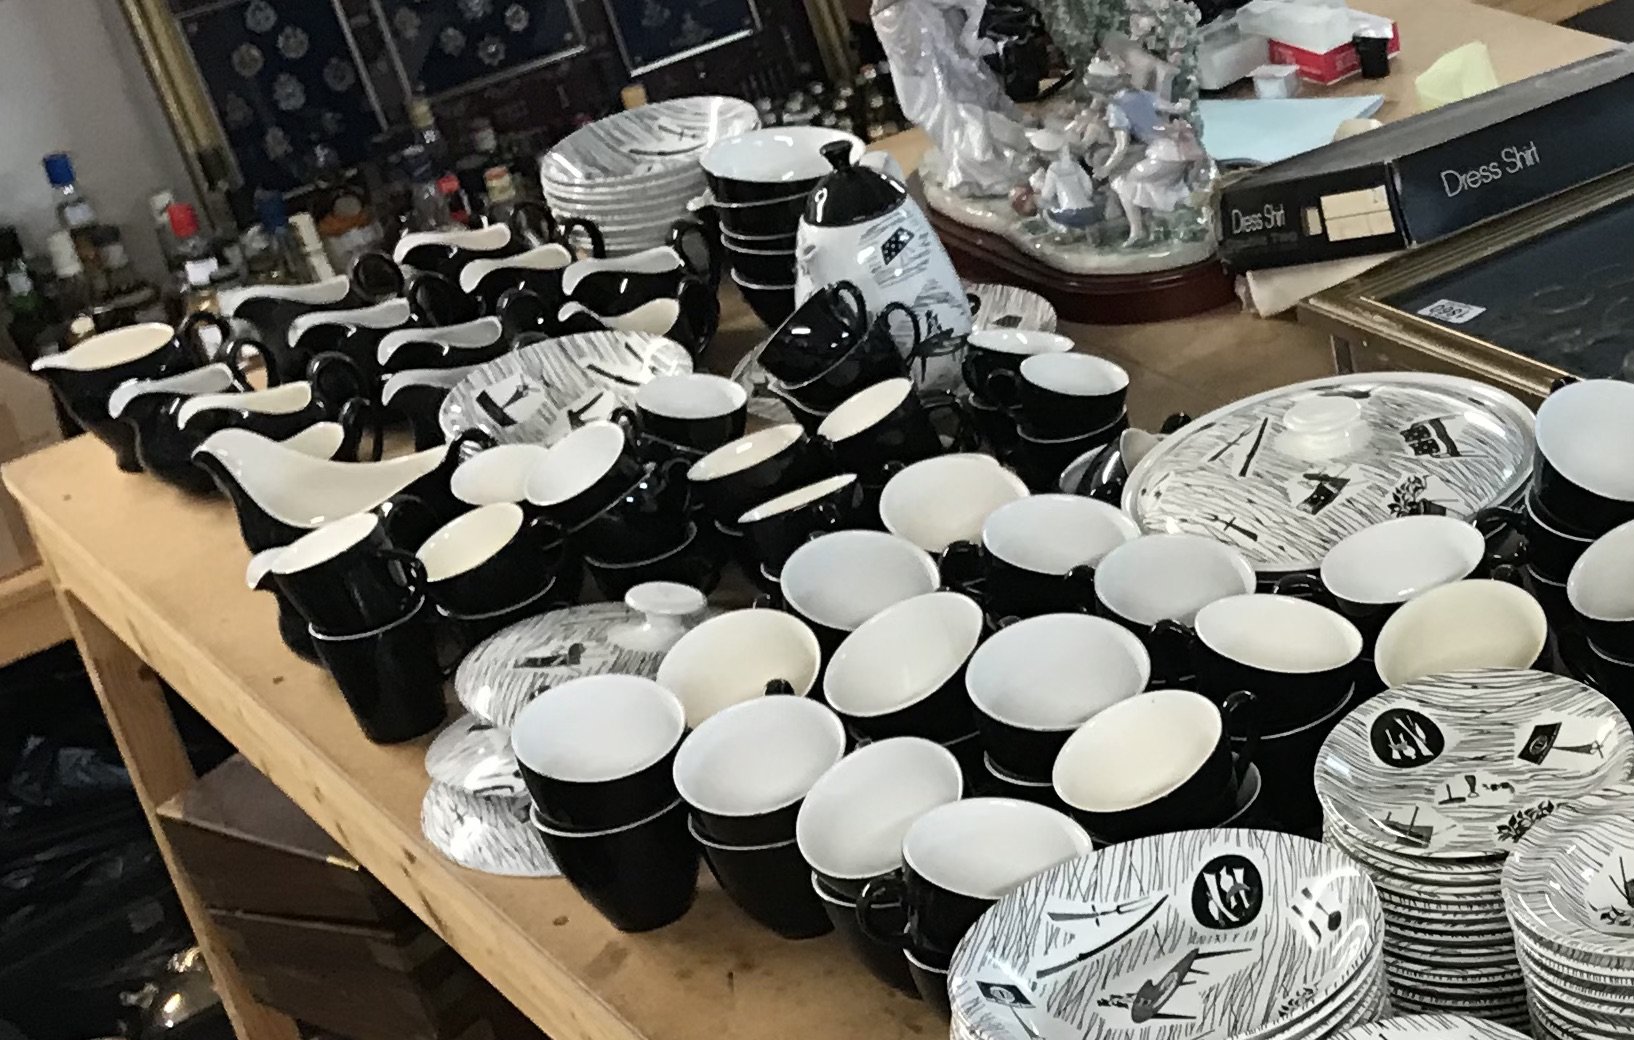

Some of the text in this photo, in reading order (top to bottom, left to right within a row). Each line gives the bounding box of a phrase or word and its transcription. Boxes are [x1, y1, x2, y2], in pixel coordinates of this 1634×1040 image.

[1440, 141, 1540, 197] Dress Shirt
[1231, 209, 1263, 234] Dress
